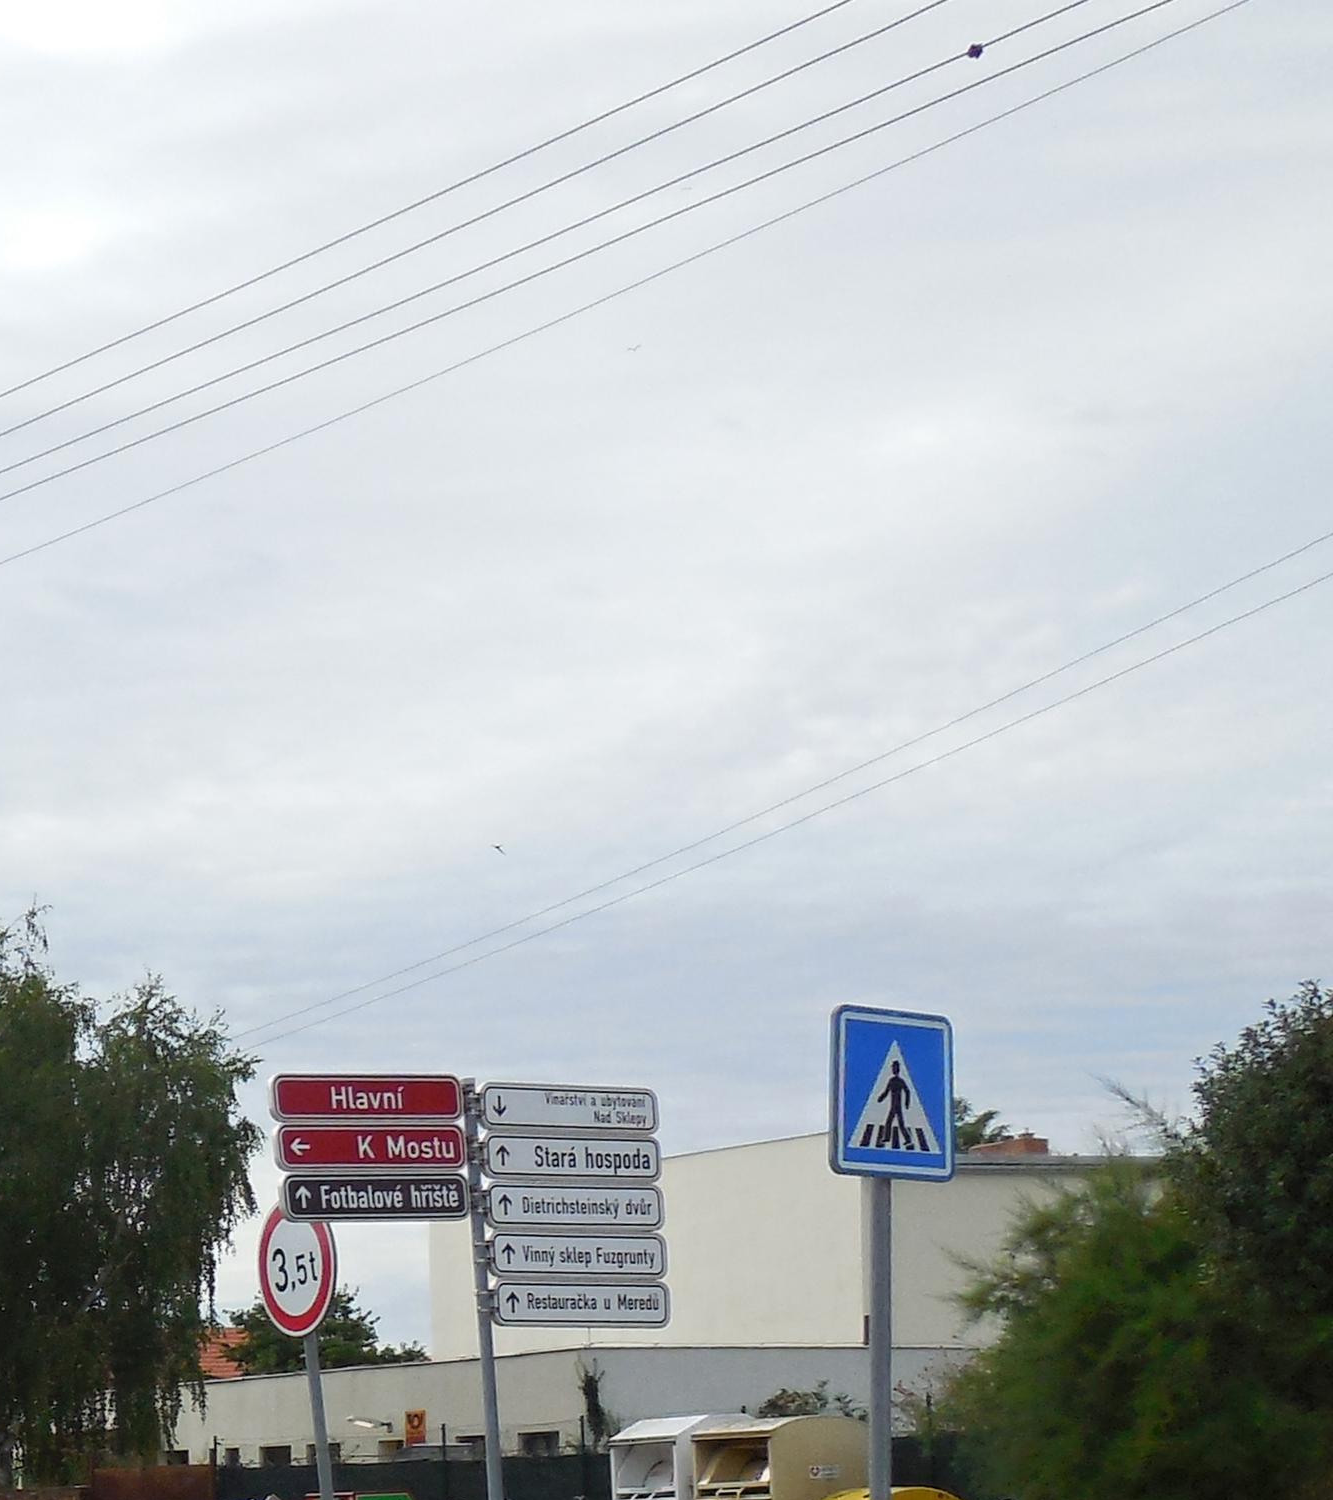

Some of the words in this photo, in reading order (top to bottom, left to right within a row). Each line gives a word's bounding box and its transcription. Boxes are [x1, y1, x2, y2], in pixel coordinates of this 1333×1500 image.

[330, 1086, 405, 1109] Hlavní
[544, 1092, 586, 1106] Vinařství
[590, 1097, 596, 1107] a
[593, 1110, 612, 1124] Nad
[616, 1111, 647, 1127] Sklepy
[357, 1135, 376, 1159] K
[386, 1135, 455, 1159] Mostu
[534, 1145, 577, 1169] Stará
[585, 1147, 651, 1175] hospoda
[319, 1184, 404, 1209] Fotbalové
[410, 1183, 460, 1208] hřiště
[522, 1196, 620, 1219] Dietrichsteinský
[625, 1199, 653, 1216] dvůr
[522, 1245, 555, 1267] Vinný
[559, 1246, 592, 1268] sklep
[596, 1247, 655, 1269] Fuzgrunty
[527, 1292, 598, 1311] Restauračka
[604, 1299, 611, 1310] u
[617, 1292, 660, 1311] Meredů
